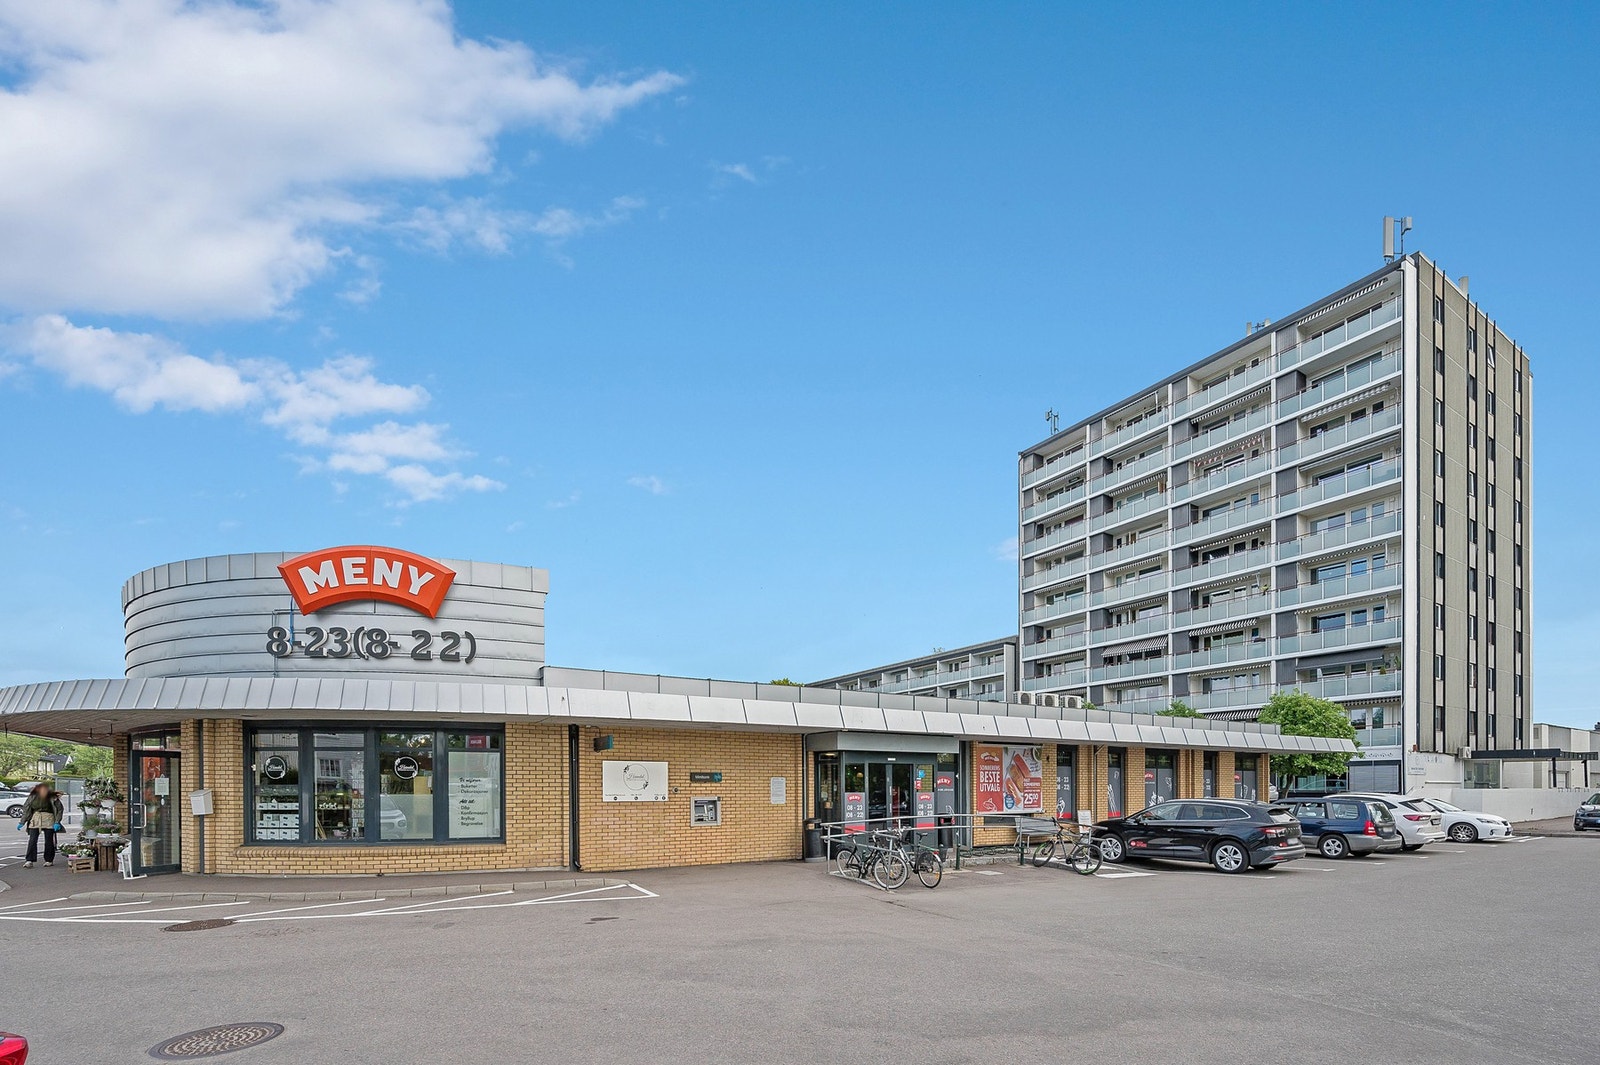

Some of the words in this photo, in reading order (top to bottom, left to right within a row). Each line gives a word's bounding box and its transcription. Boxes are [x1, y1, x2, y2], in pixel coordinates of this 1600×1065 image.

[298, 557, 435, 595] MENY
[980, 771, 1000, 783] BESTE
[980, 783, 1000, 792] UTVALG
